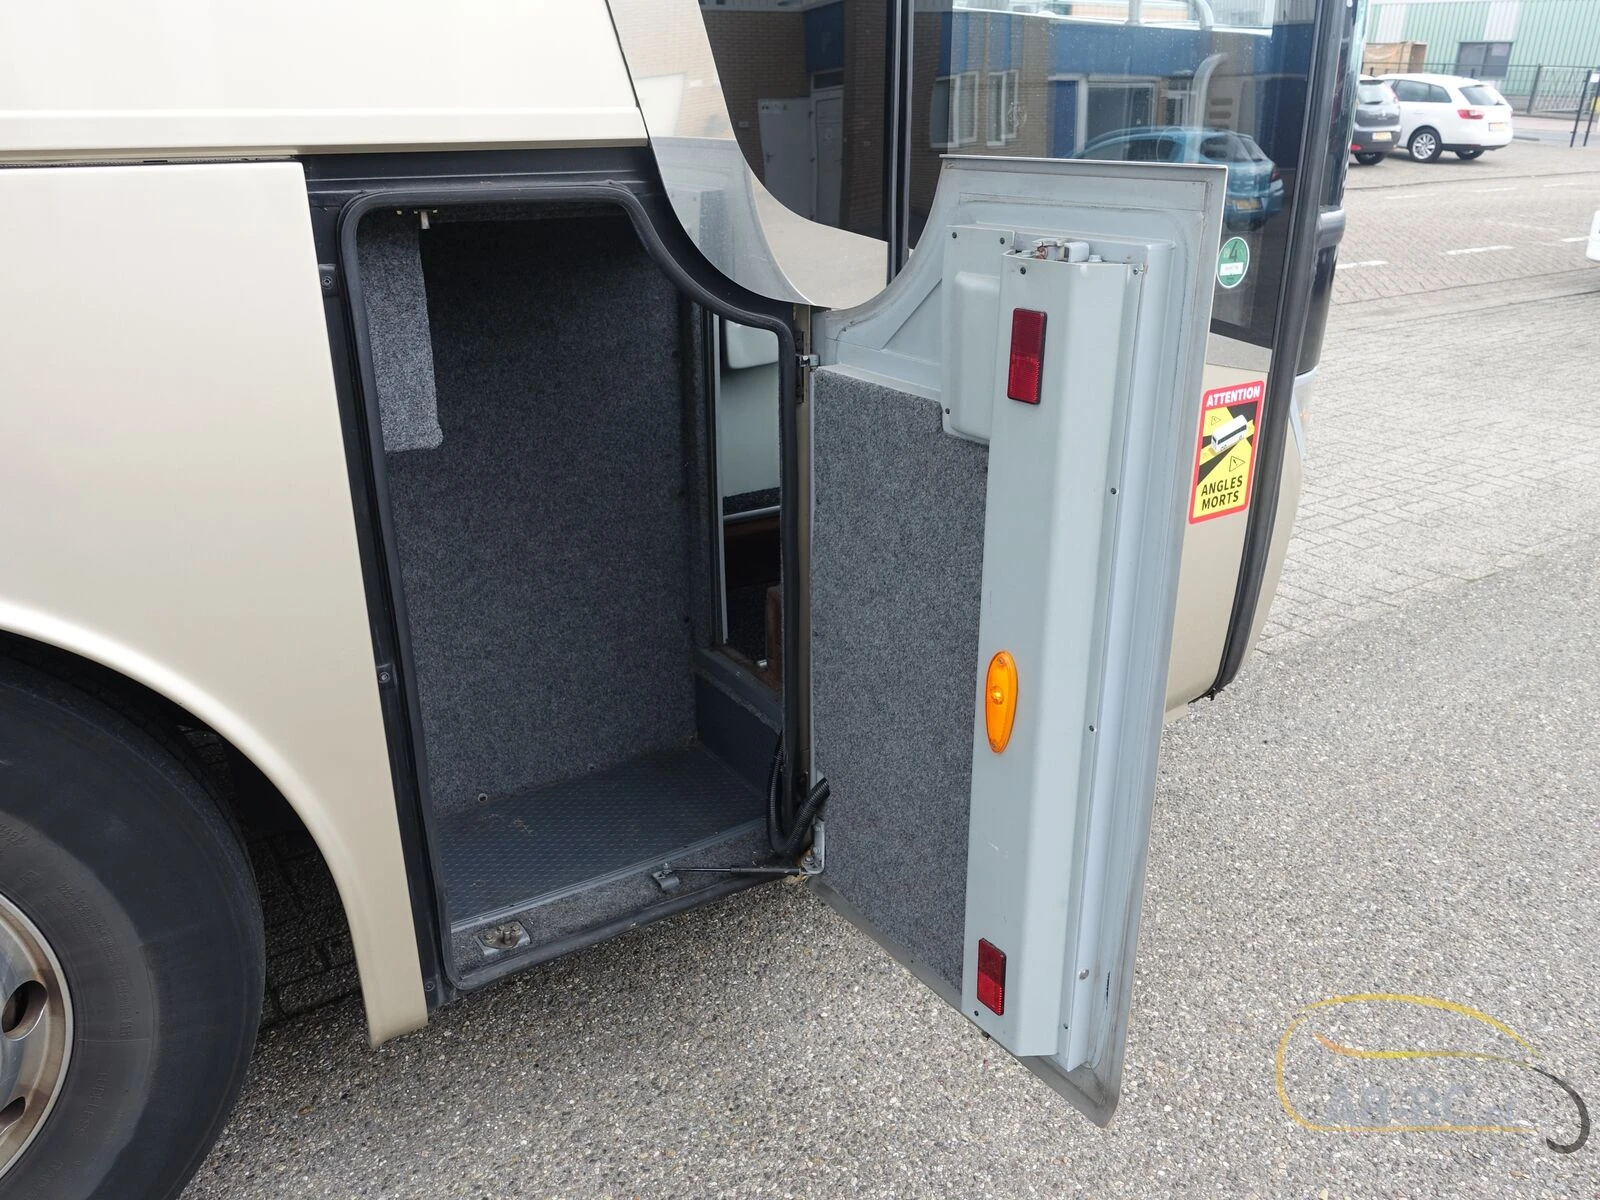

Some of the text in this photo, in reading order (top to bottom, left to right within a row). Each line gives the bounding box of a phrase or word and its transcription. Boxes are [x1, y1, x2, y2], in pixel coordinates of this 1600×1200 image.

[1228, 240, 1238, 262] 4
[1206, 385, 1261, 408] ATTENTION
[1200, 475, 1243, 497] ANGLES
[1201, 490, 1239, 511] MORTS
